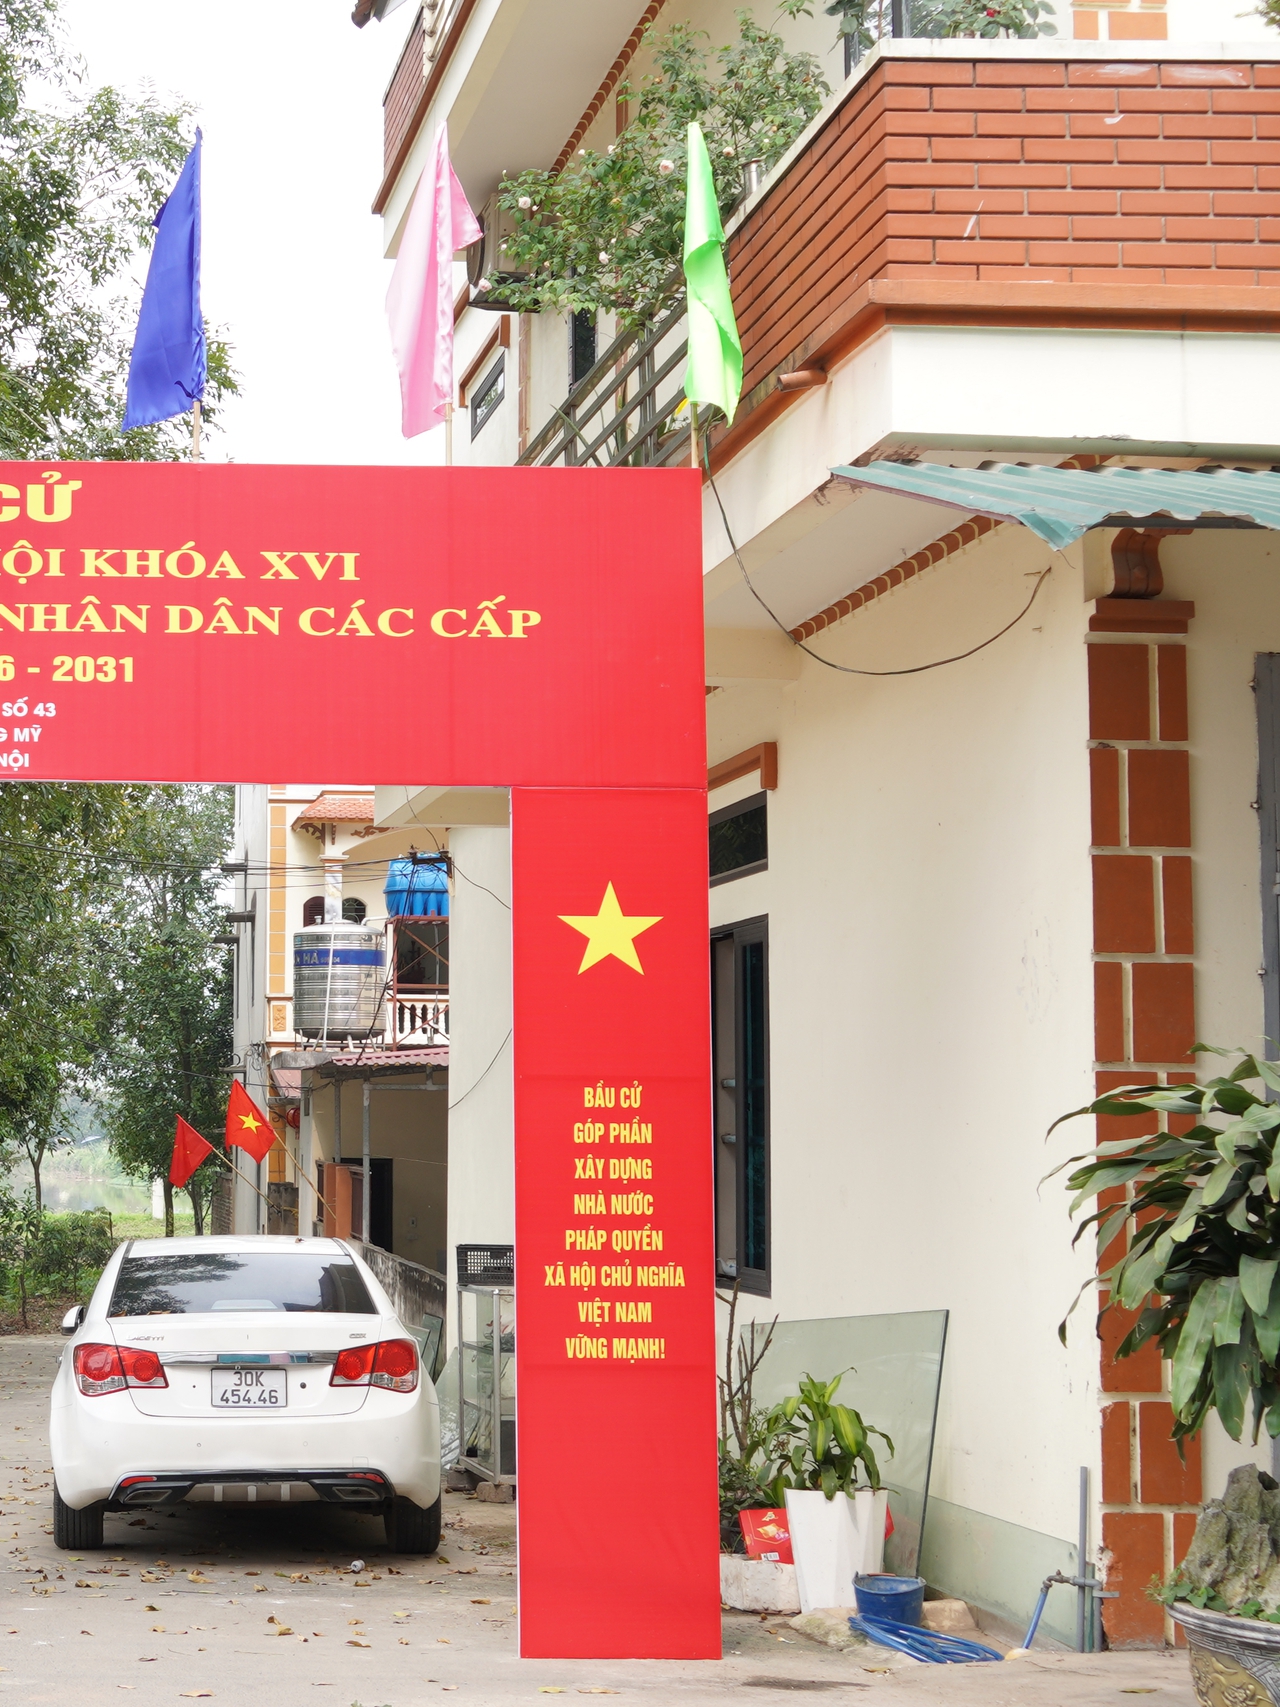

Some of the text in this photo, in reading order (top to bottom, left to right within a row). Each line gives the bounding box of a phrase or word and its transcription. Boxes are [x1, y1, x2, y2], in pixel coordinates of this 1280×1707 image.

[80, 541, 245, 578] KHÓA
[260, 552, 360, 580] XVI
[164, 597, 283, 635] DÂN
[299, 599, 414, 637] CÁC
[431, 595, 541, 638] CẤP
[52, 656, 133, 682] 2031
[2, 697, 28, 717] SỐ
[33, 703, 56, 717] 43
[14, 725, 42, 742] MỸ
[584, 1080, 642, 1108] BẦU CỬ
[574, 1116, 652, 1143] GÓP PHẦN
[575, 1154, 652, 1183] XÂY DỰNG
[574, 1190, 653, 1215] NHÀ NƯỚC
[566, 1224, 663, 1253] PHÁP QUYỀN
[545, 1259, 685, 1291] XÃ HỘI CHỦ NGHĨA
[578, 1297, 652, 1327] VIỆT NAM
[566, 1334, 665, 1363] VỮNG MẠNH!
[233, 1371, 265, 1387] 30K
[220, 1388, 279, 1405] 454.46
